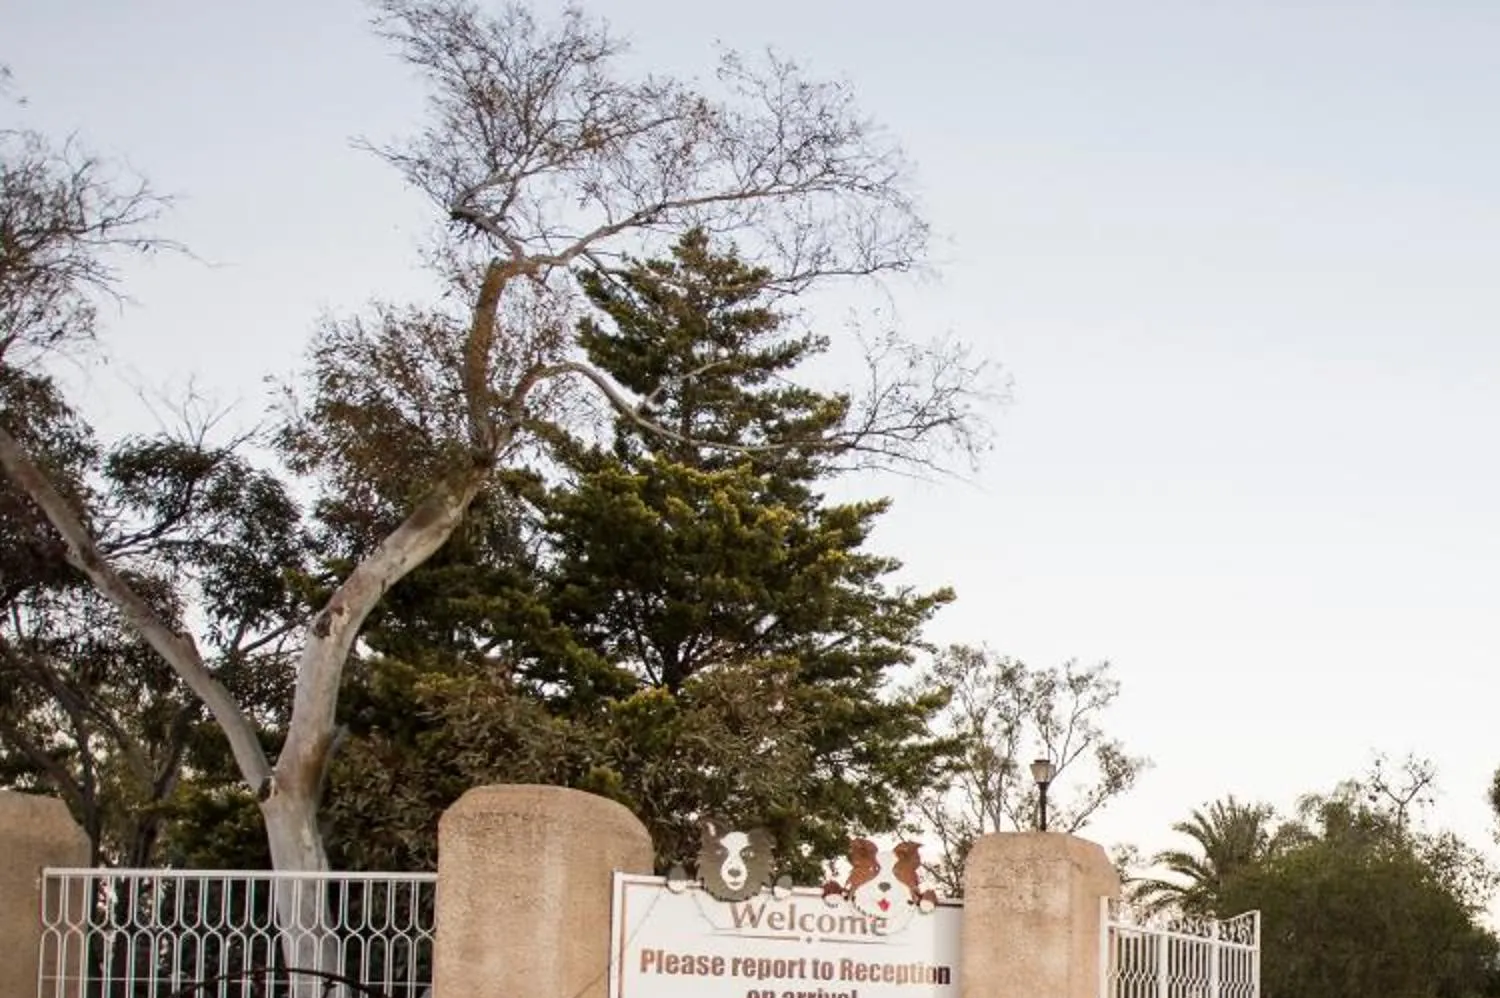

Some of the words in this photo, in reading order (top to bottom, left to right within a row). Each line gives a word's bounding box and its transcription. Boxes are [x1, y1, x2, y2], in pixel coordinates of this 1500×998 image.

[729, 900, 888, 936] Welcome
[640, 948, 725, 976] Please
[731, 956, 806, 981] report
[812, 959, 834, 981] to
[839, 957, 951, 985] Reception
